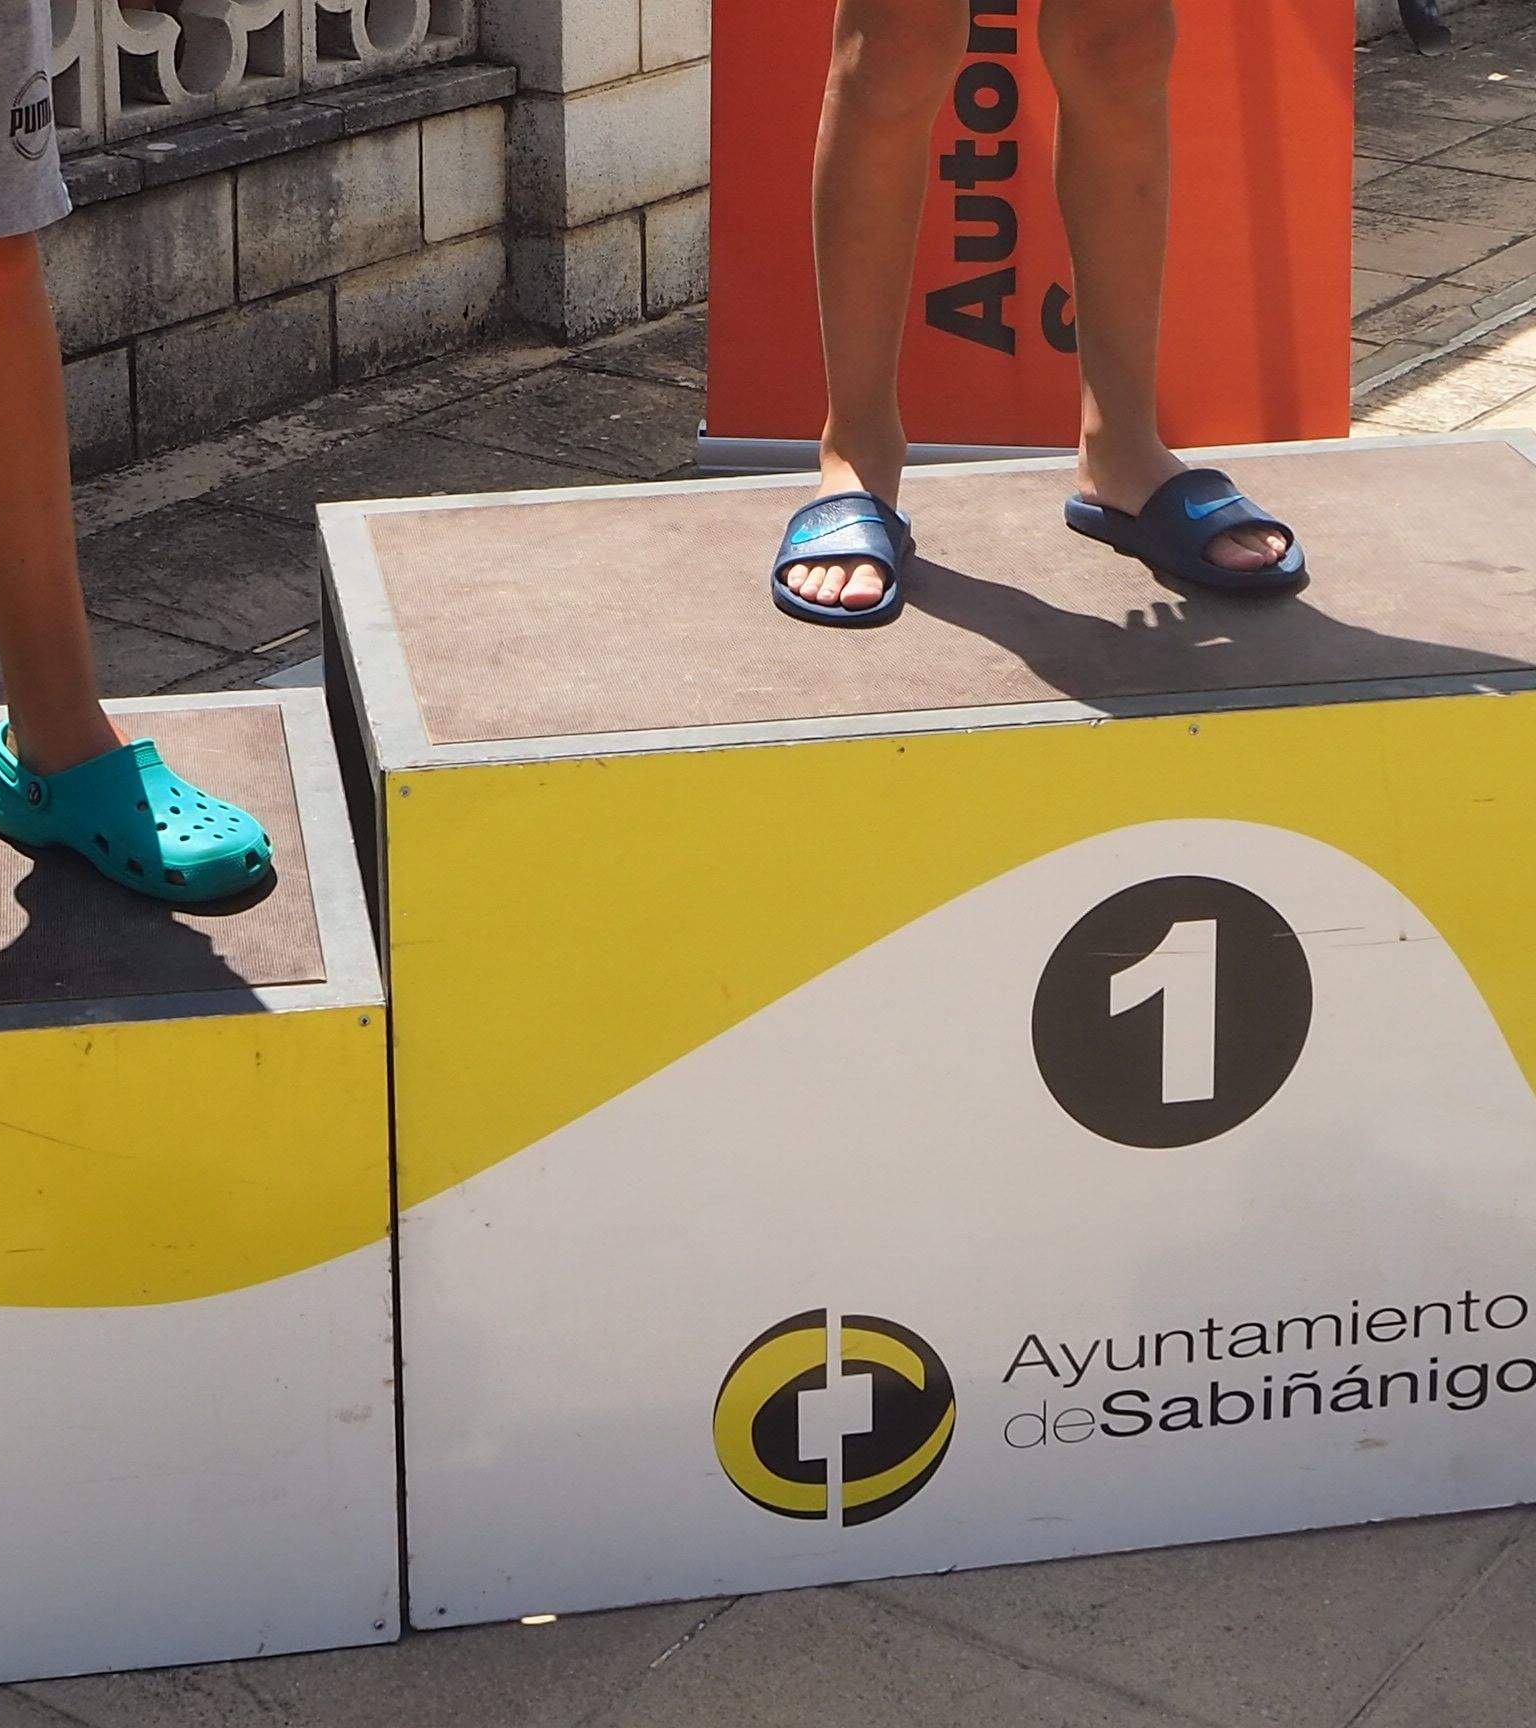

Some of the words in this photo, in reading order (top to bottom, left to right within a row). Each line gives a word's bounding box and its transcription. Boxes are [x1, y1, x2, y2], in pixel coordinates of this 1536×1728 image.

[10, 97, 53, 137] PUM
[1110, 918, 1218, 1105] 1
[1002, 1289, 1530, 1388] Ayuntamiento
